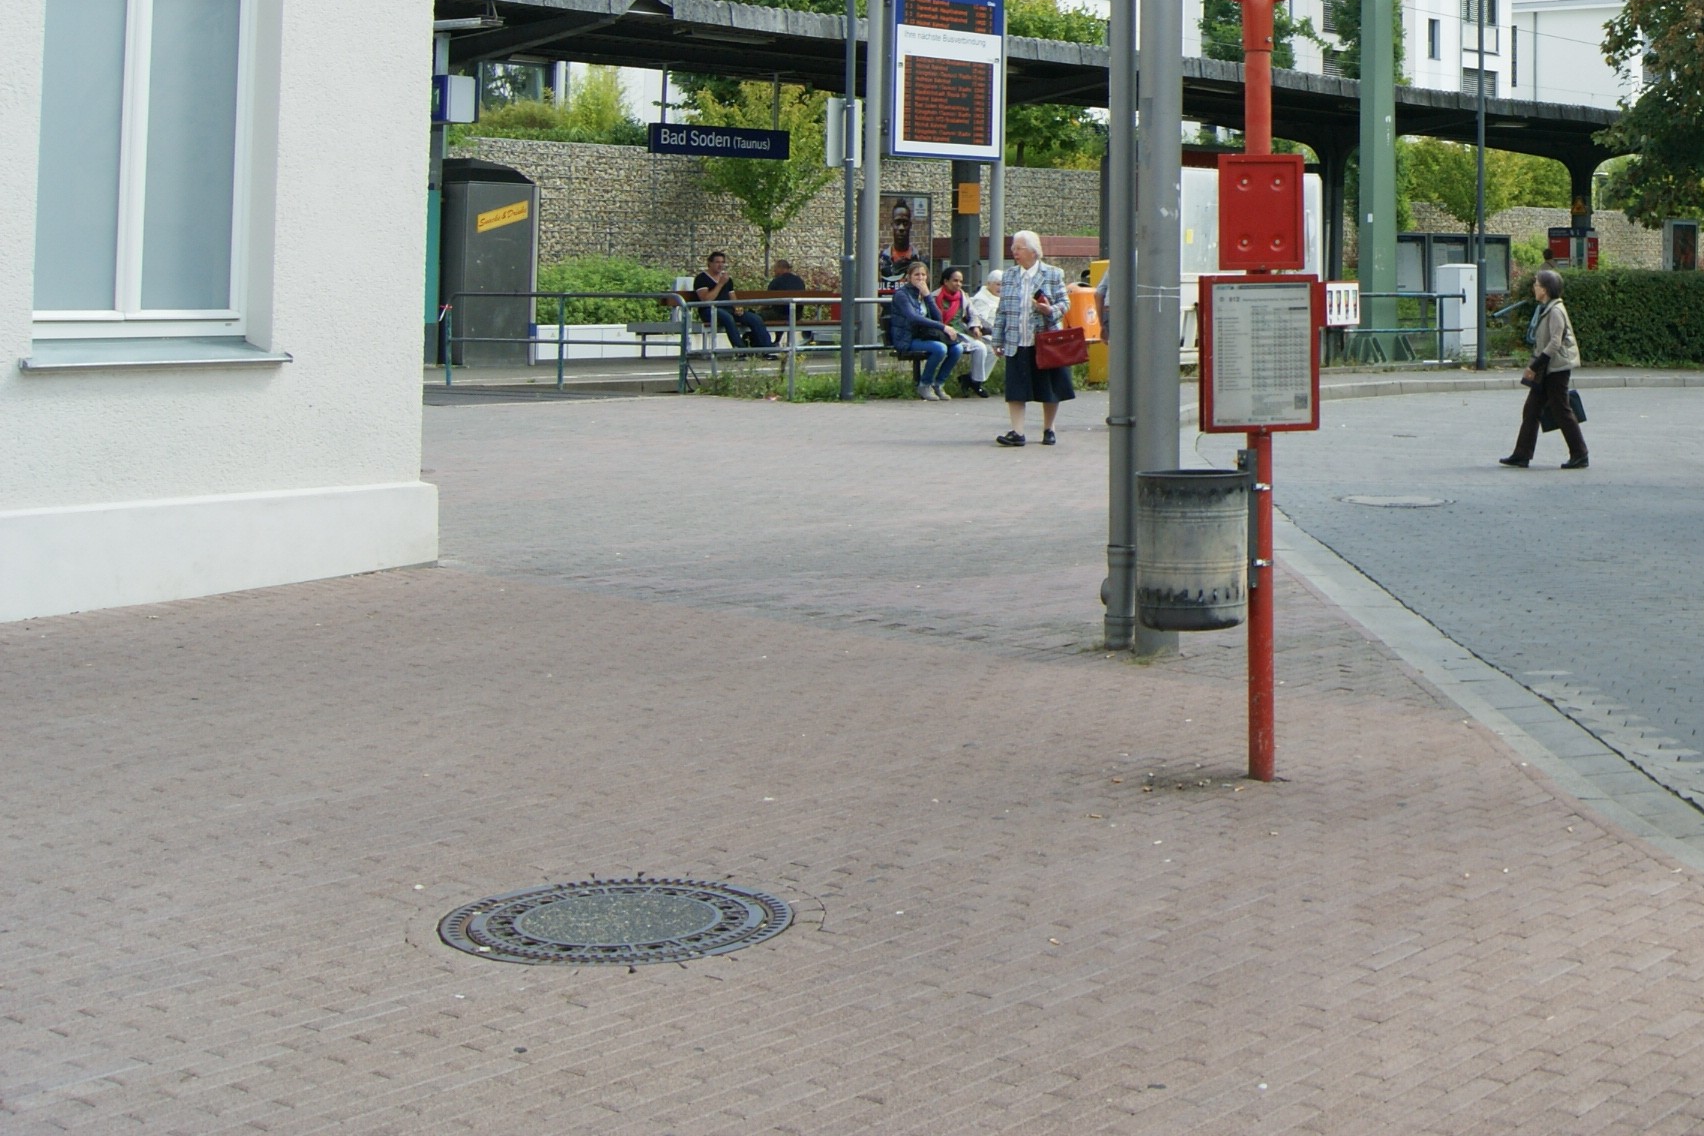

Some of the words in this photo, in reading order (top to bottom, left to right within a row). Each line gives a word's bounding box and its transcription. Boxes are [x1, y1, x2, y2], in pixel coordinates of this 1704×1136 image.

[660, 128, 687, 145] Bad
[690, 130, 731, 148] Soden
[733, 136, 771, 151] (Taunus)
